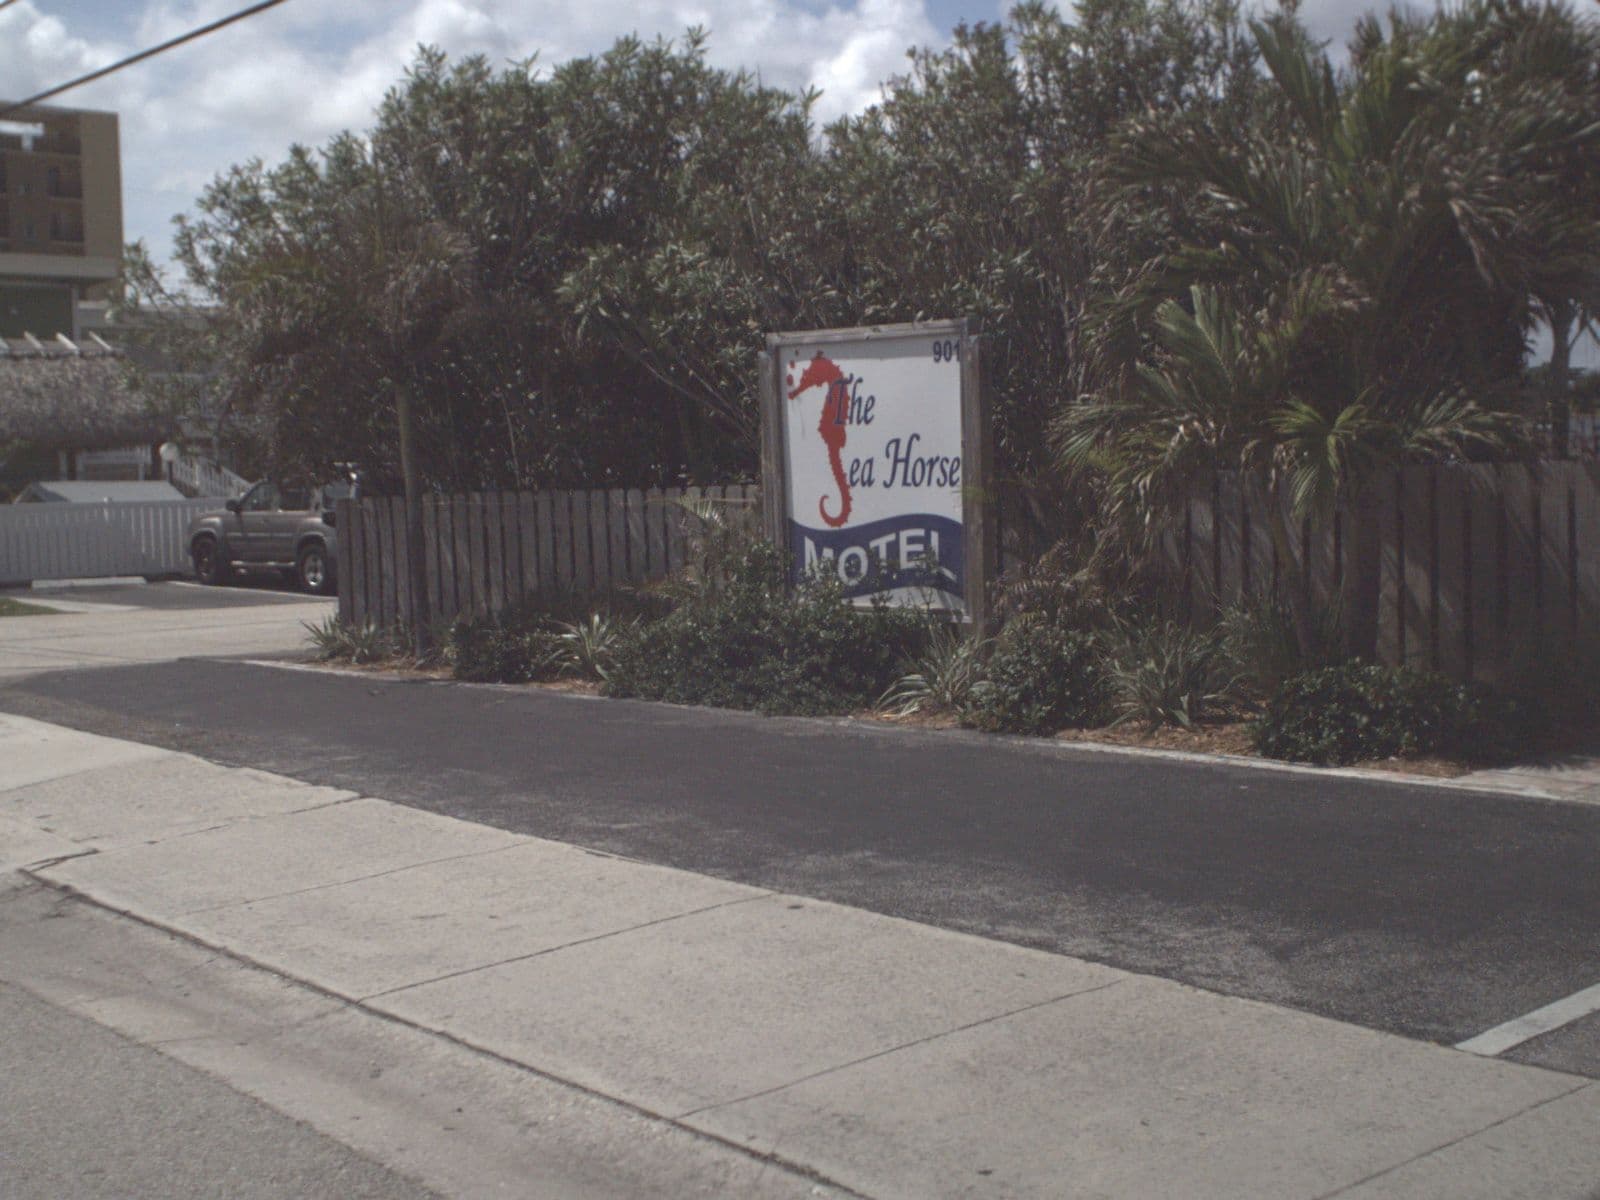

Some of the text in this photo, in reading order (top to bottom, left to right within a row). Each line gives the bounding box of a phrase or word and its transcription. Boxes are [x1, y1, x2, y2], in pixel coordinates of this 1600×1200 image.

[933, 340, 961, 363] 901
[828, 373, 875, 426] The
[883, 433, 961, 489] Horse
[804, 528, 957, 586] MOTEL
